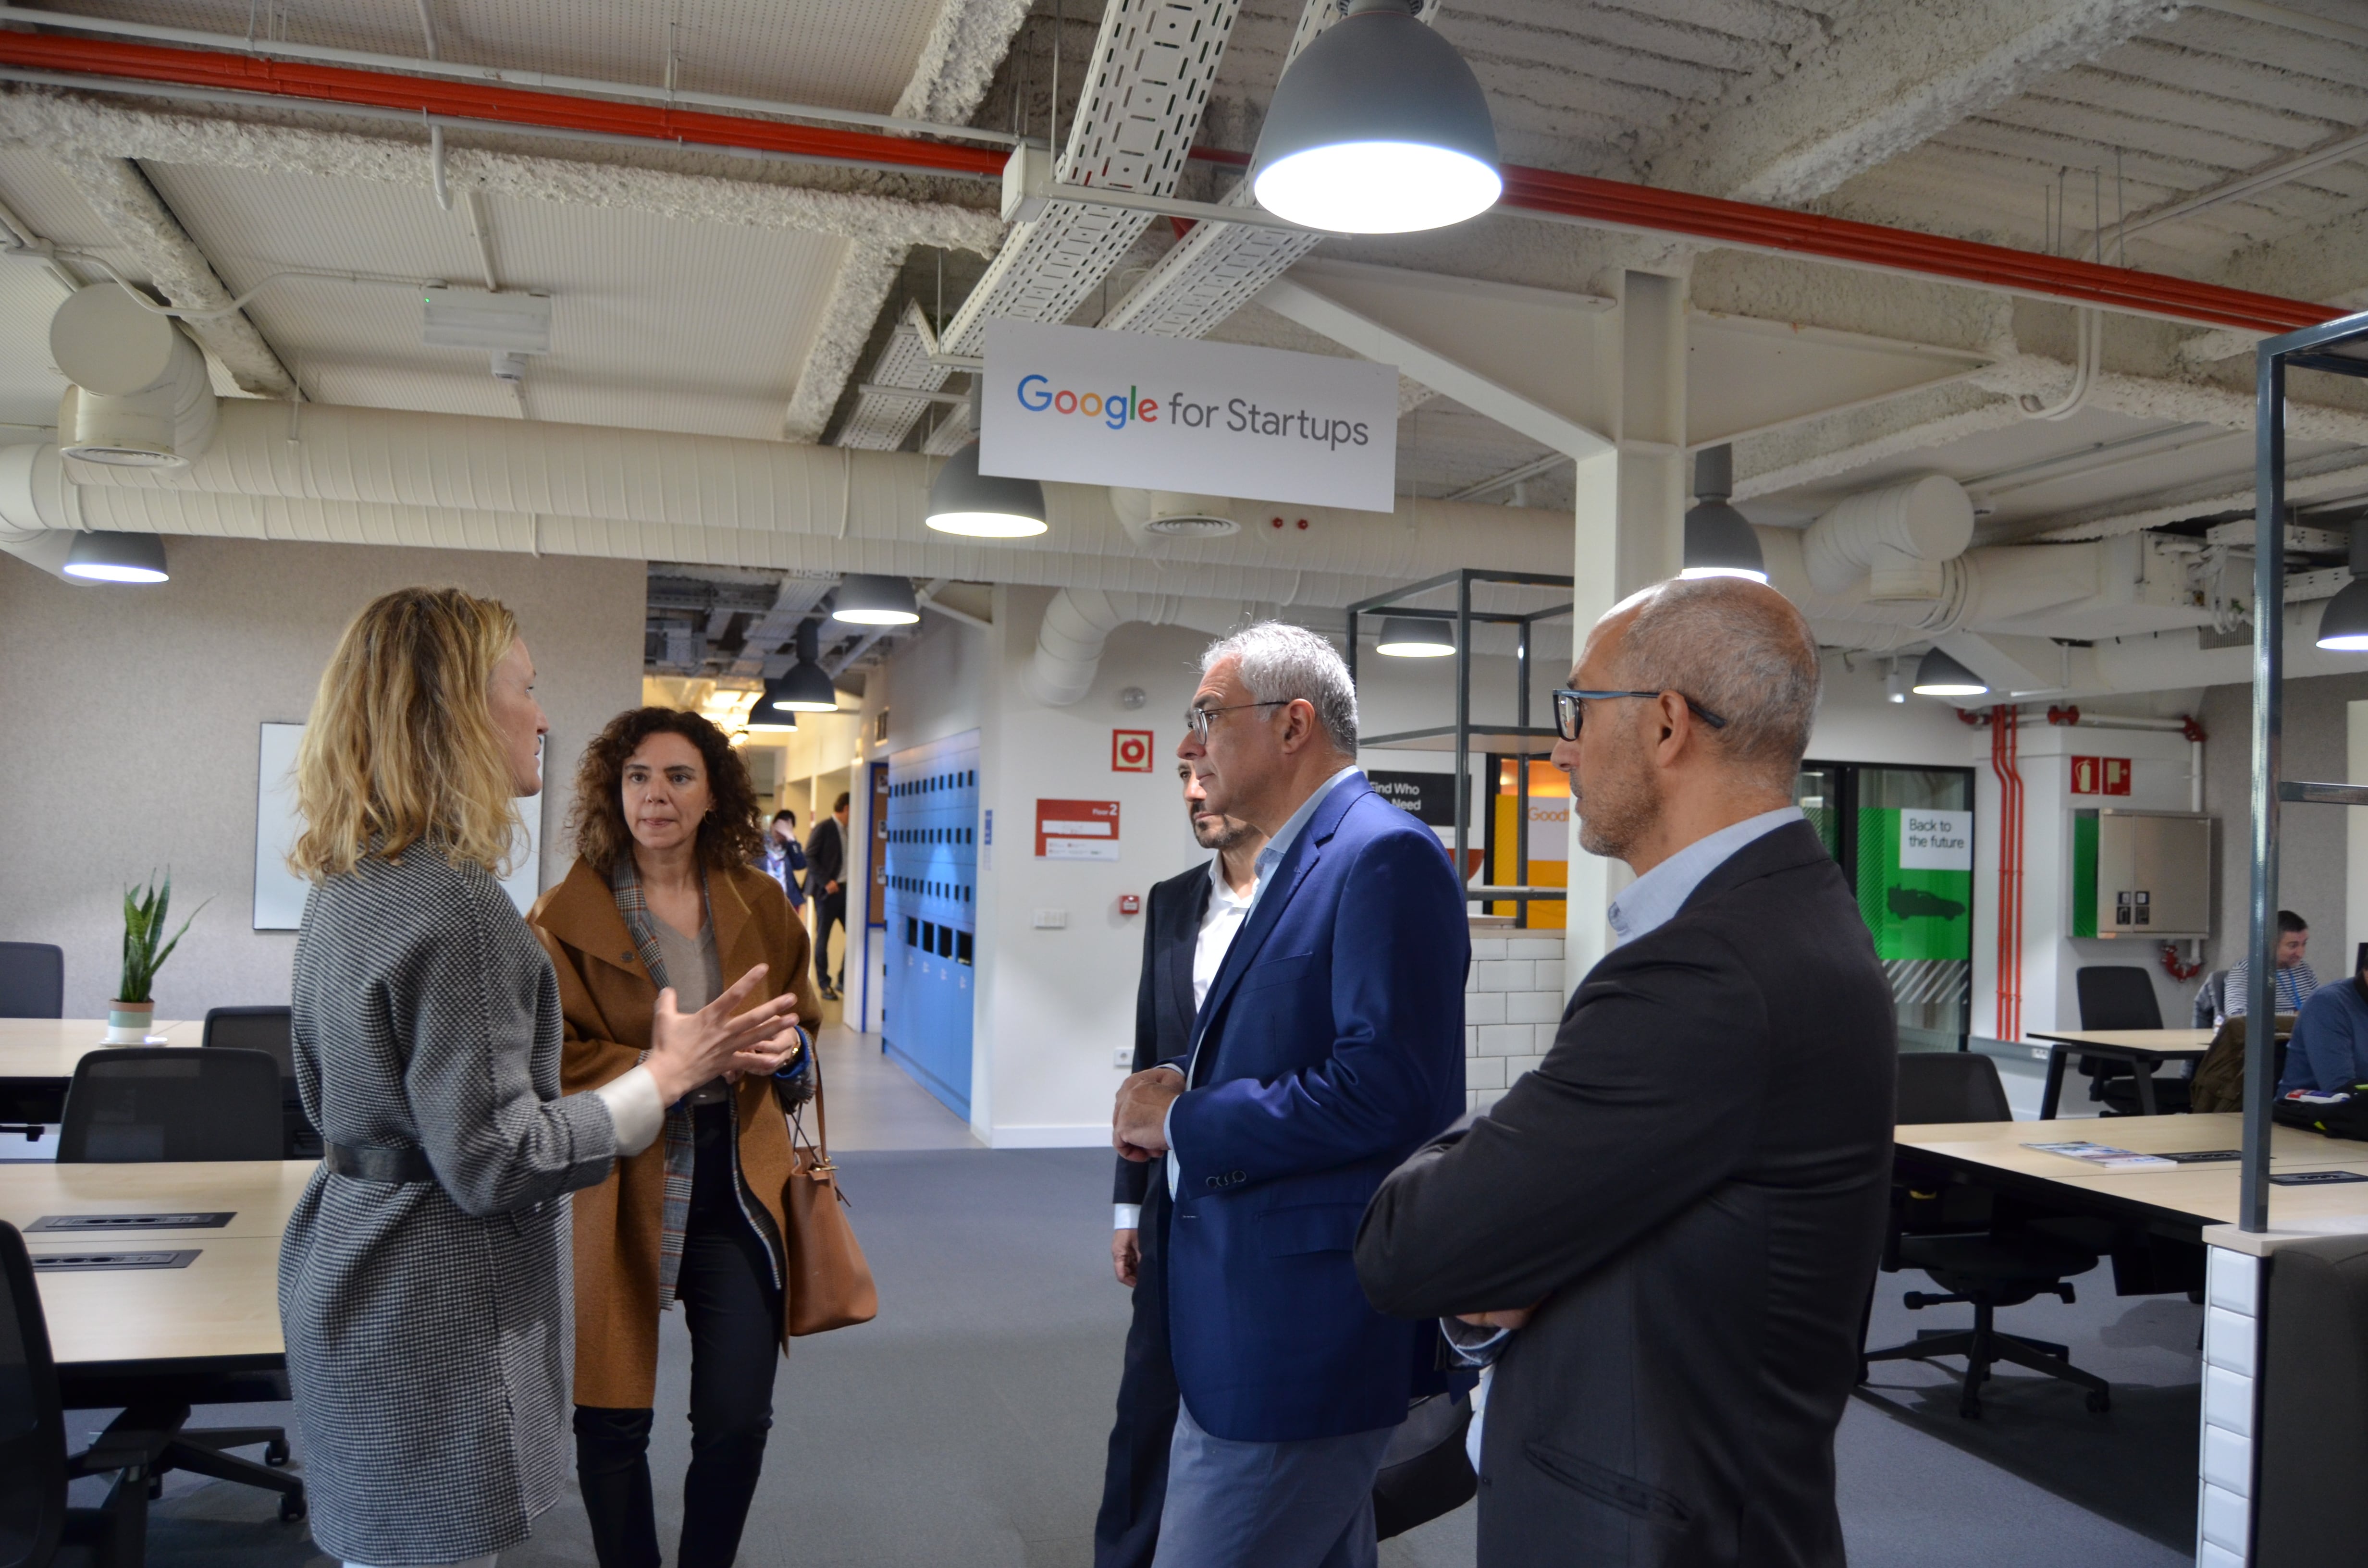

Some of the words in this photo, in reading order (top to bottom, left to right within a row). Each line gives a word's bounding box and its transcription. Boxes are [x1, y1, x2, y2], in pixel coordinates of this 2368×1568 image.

[1017, 374, 1158, 430] Google
[1169, 392, 1219, 428] for
[1227, 398, 1369, 451] Startups
[1394, 783, 1420, 795] Who
[1109, 804, 1117, 816] 2
[1392, 798, 1421, 810] Need
[1909, 818, 1936, 831] Back
[1940, 821, 1951, 832] to
[1909, 835, 1928, 847] the
[1931, 835, 1965, 848] future
